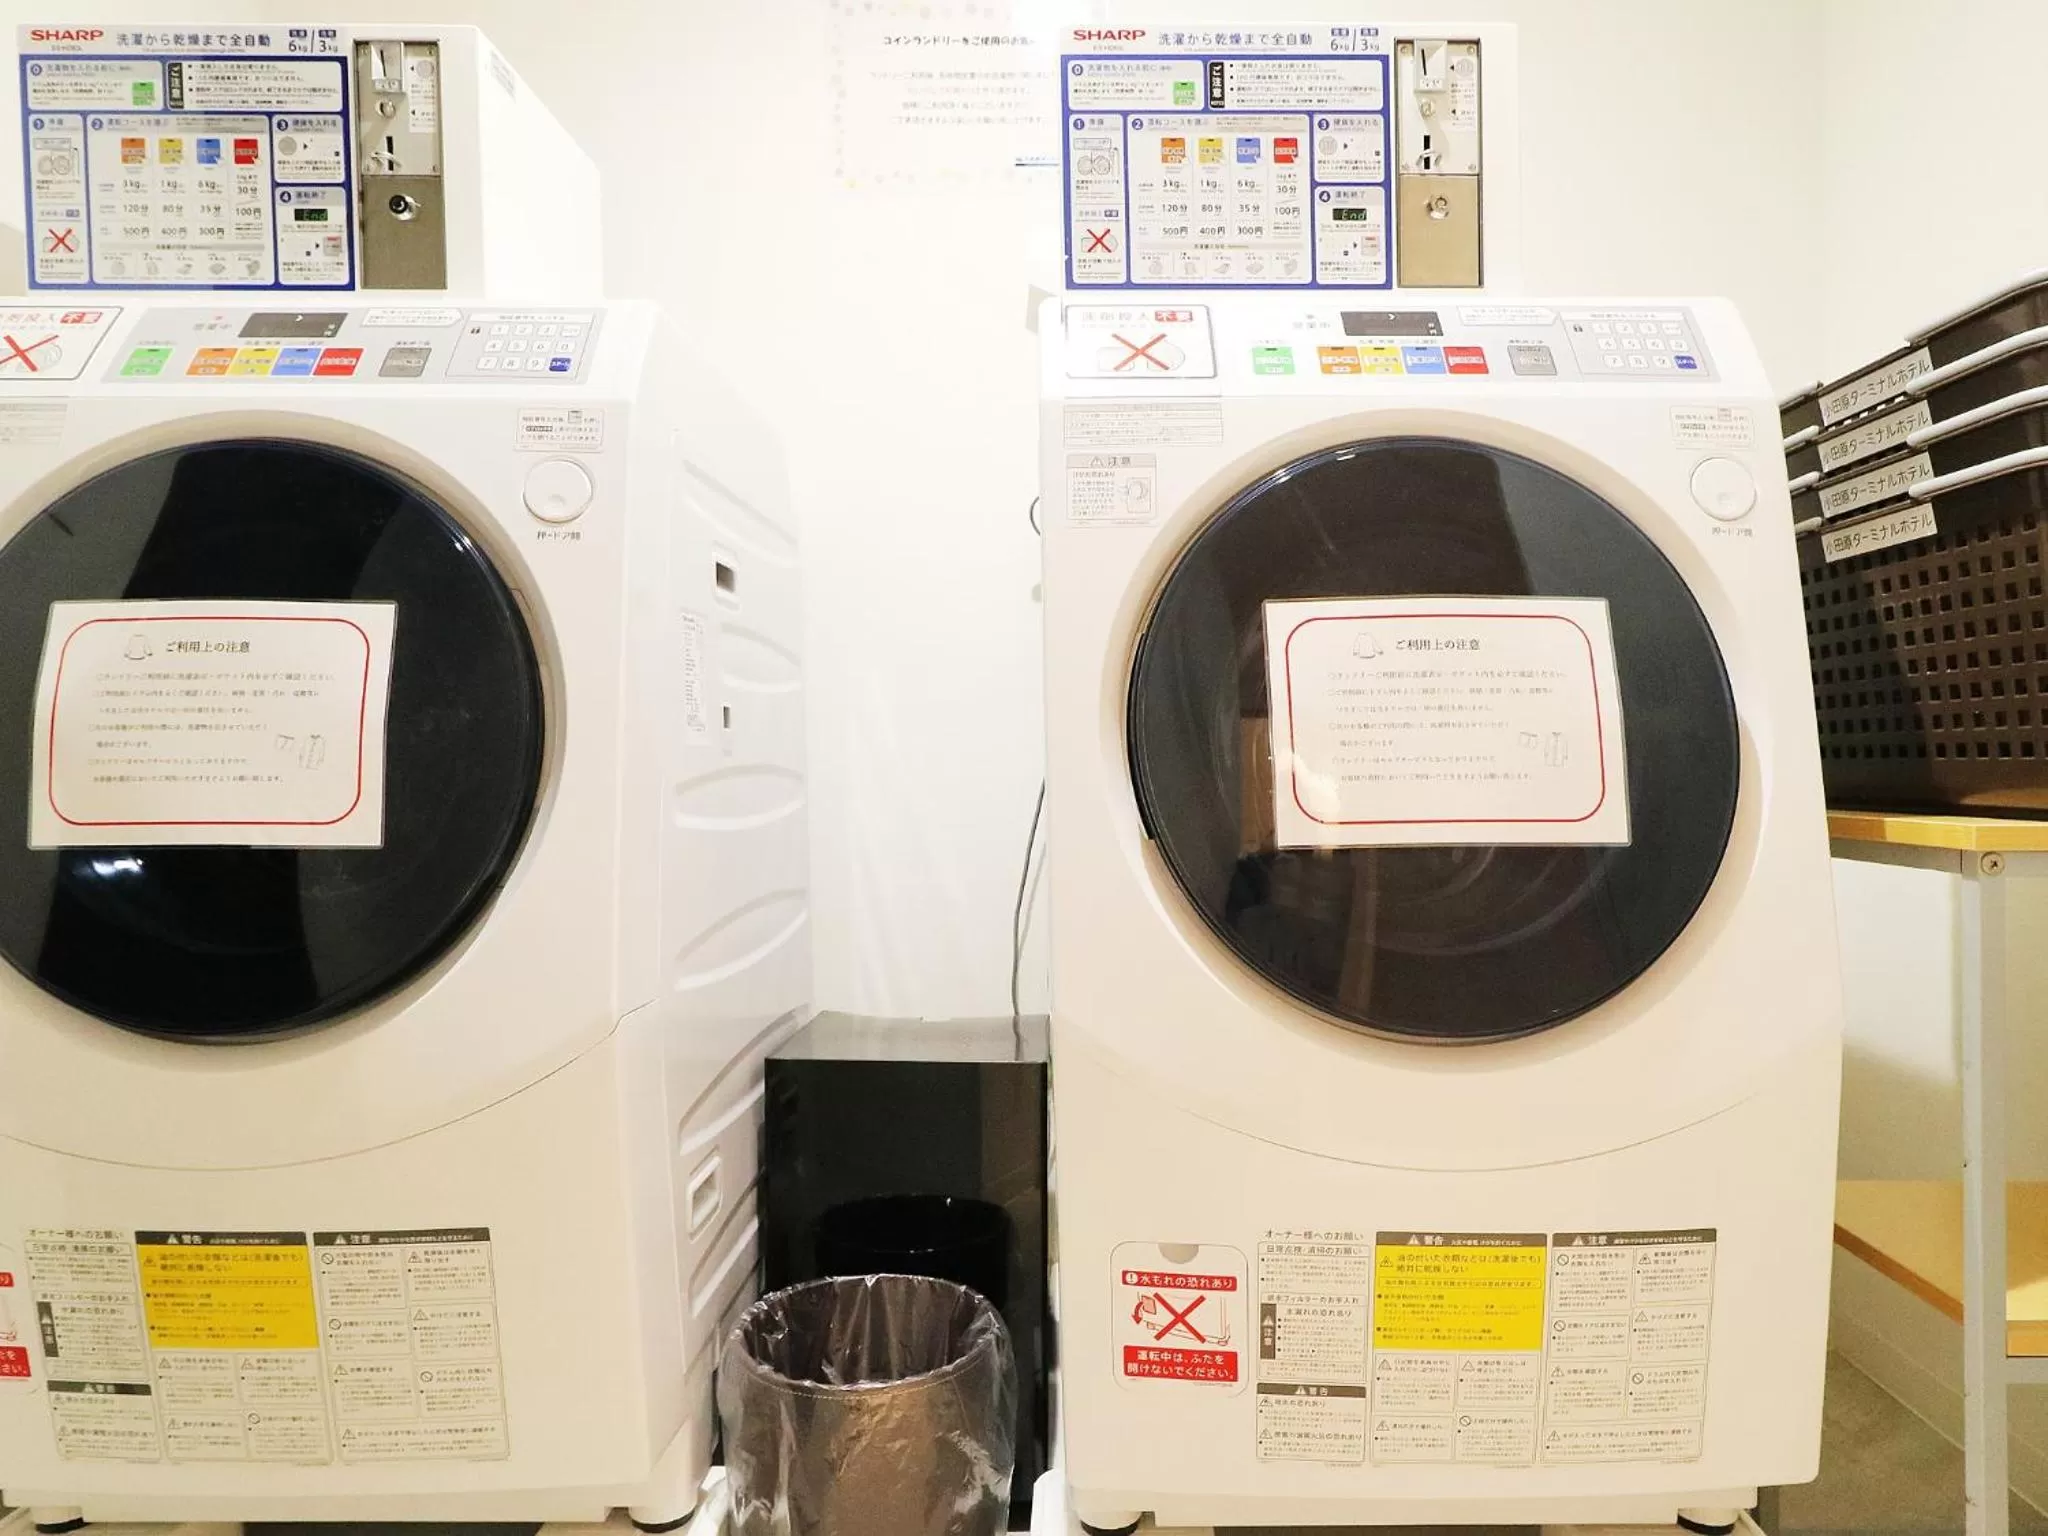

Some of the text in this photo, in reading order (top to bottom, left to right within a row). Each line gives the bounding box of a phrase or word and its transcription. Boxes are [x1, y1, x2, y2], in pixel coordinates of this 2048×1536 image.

[31, 30, 104, 41] SHARP
[117, 33, 270, 46] 洗濯から乾燥まで全自動
[1073, 29, 1146, 41] SHARP
[1159, 32, 1312, 46] 洗濯から乾燥まで全自動
[1276, 186, 1297, 194] 30分
[124, 204, 149, 212] 120分
[236, 208, 262, 216] 100円
[1162, 204, 1188, 212] 120分
[1201, 204, 1222, 212] 80分
[1239, 204, 1260, 212] 35分
[1274, 206, 1300, 215] 100円
[123, 227, 150, 236] 500円
[1162, 226, 1188, 236] 500円
[1200, 226, 1226, 236] 400円
[1237, 226, 1264, 236] 300円
[1824, 358, 1931, 419] 小田原ターミナルホテル
[1822, 412, 1930, 466] 小田原ターミナルホテル
[1824, 462, 1930, 511] 小田原ターミナルホテル
[1826, 514, 1932, 556] 小田原ターミナルホテル
[166, 640, 250, 654] ご利用上の注意
[1396, 638, 1480, 652] ご利用上の注意
[181, 1234, 202, 1244] 警告
[1264, 1228, 1364, 1241] オーナー様へのお願い
[1588, 1235, 1608, 1245] 注意
[1424, 1235, 1444, 1246] 警告
[1139, 1274, 1234, 1290] 水もれの恐れあり
[1127, 1363, 1235, 1380] 開けないでください。
